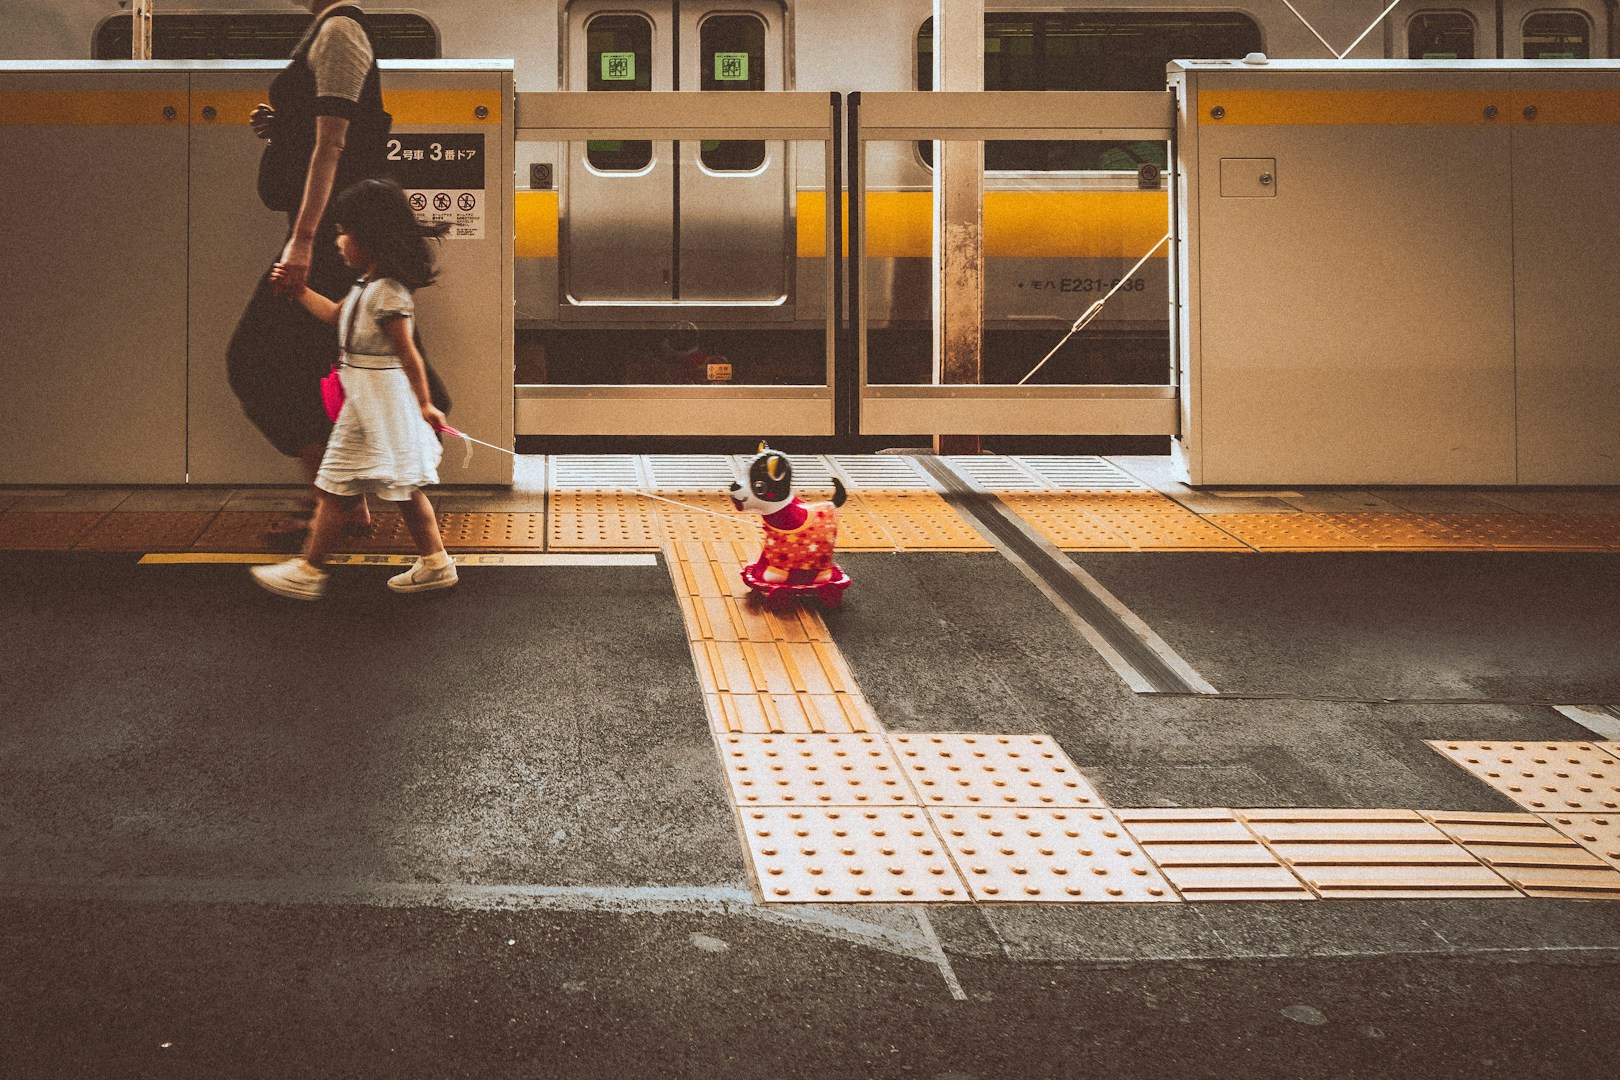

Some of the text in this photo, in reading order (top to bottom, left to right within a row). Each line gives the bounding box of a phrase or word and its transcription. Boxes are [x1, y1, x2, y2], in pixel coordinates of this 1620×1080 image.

[386, 139, 477, 161] 2号車 3番ドア
